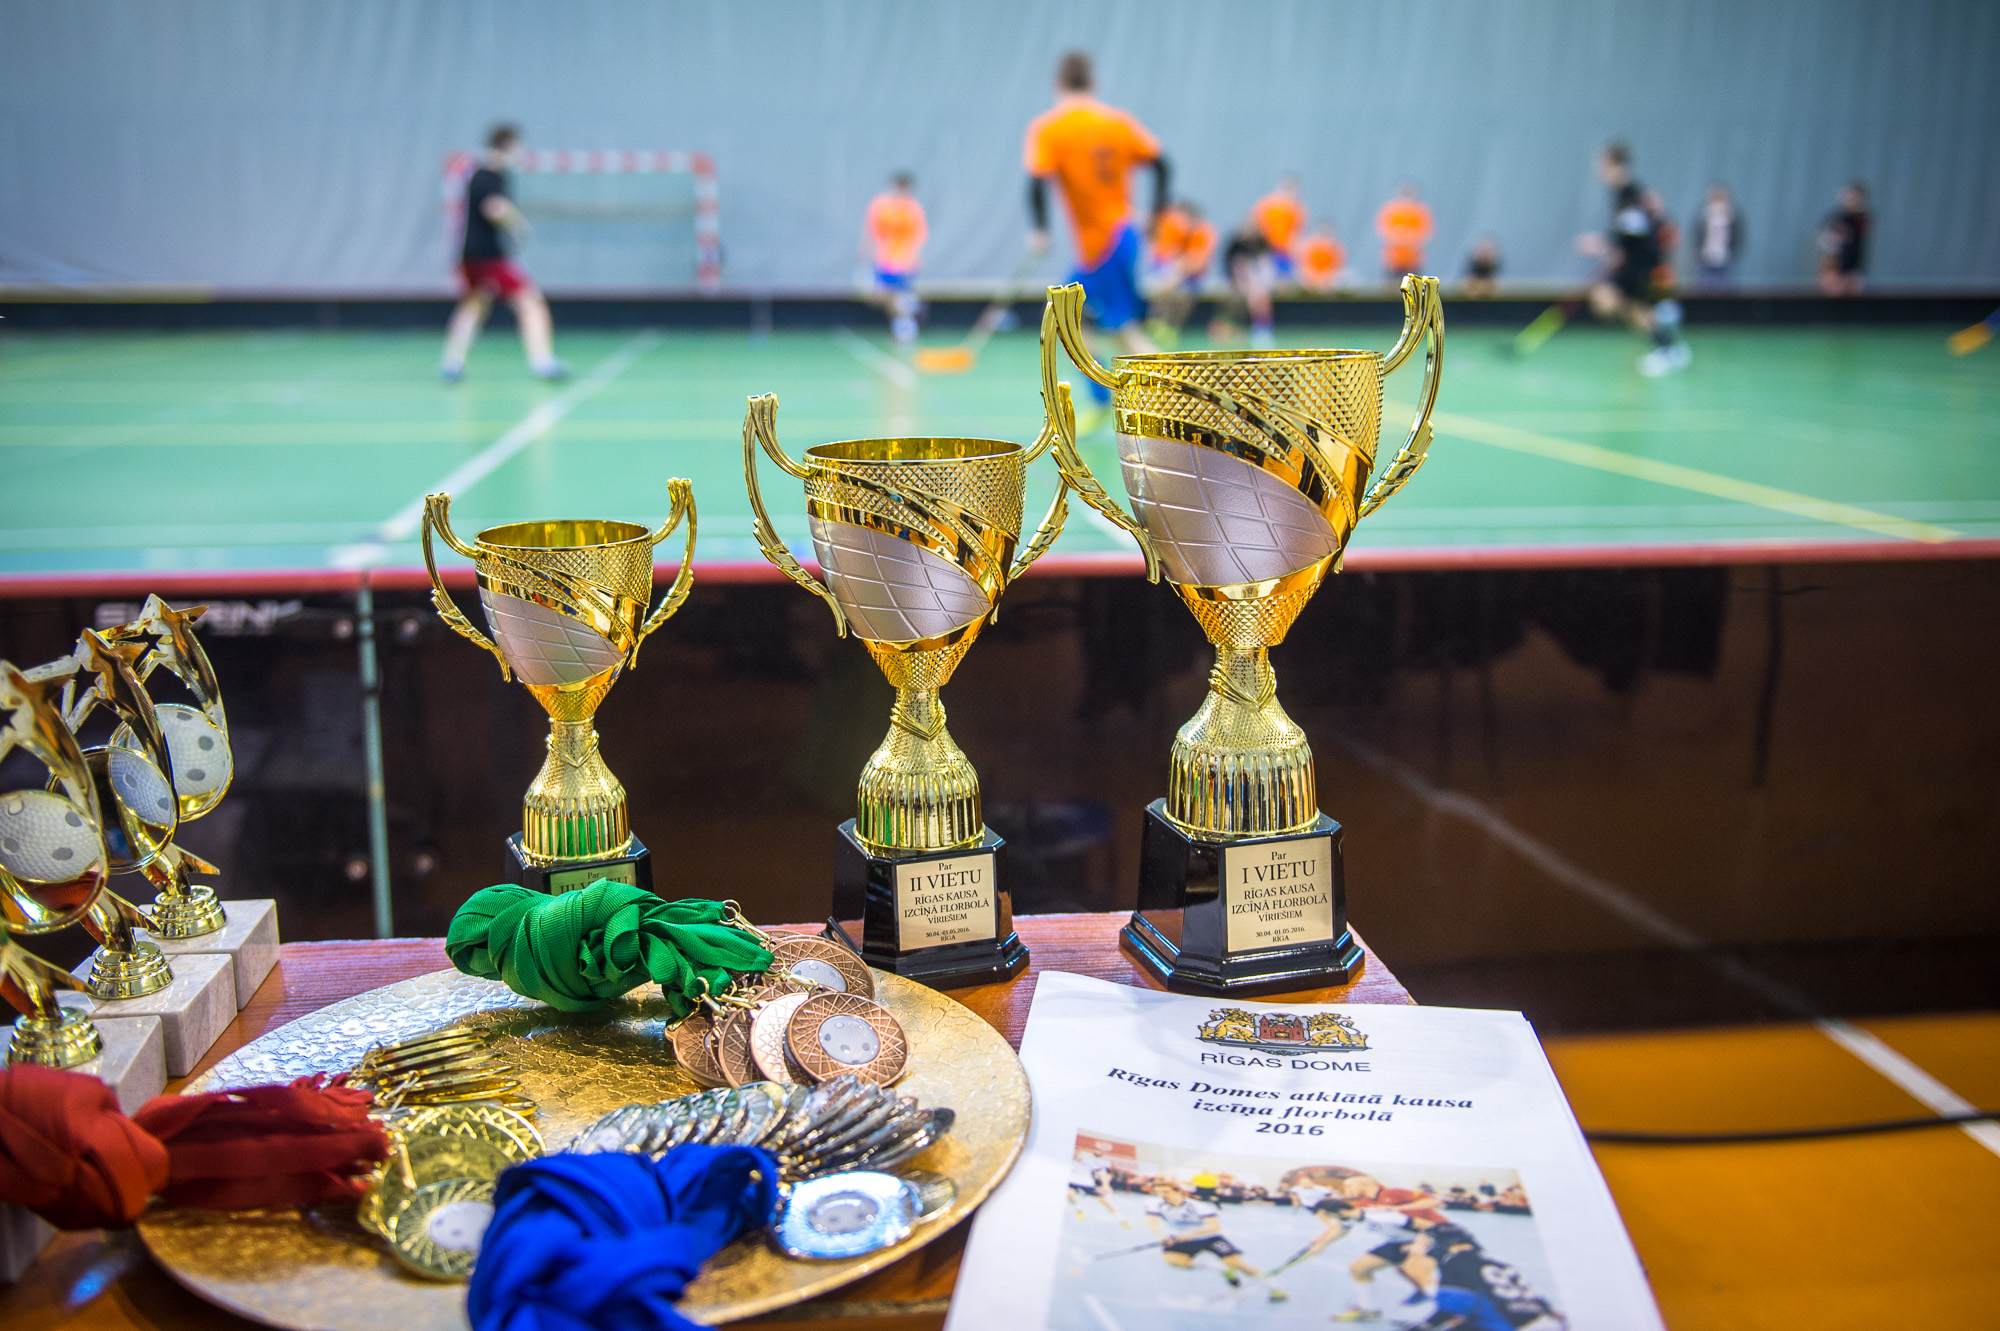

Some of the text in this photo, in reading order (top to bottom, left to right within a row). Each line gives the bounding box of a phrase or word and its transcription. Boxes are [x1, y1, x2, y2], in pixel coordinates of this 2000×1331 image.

[1271, 851, 1287, 861] Par
[938, 862, 952, 871] Par
[1242, 860, 1316, 884] I VIETU
[911, 869, 982, 891] II VIETU
[915, 889, 978, 905] RĪGAS KAUSA
[1244, 883, 1315, 899] RĪGAS KAUSA
[904, 899, 990, 917] IZCĪŅĀ FLORBOLĀ
[1231, 892, 1328, 915] IZCĪŅĀ FLORBOLĀ
[928, 912, 968, 924] VĪRIEŠIEM
[1258, 909, 1303, 922] VĪRIEŠIEM
[1200, 1052, 1372, 1073] RĪGAS DOME
[1106, 1067, 1474, 1109] Rīgas Domes atklātā kausa
[1192, 1098, 1393, 1123] izcīņa florbolā
[1255, 1121, 1325, 1137] 2016
